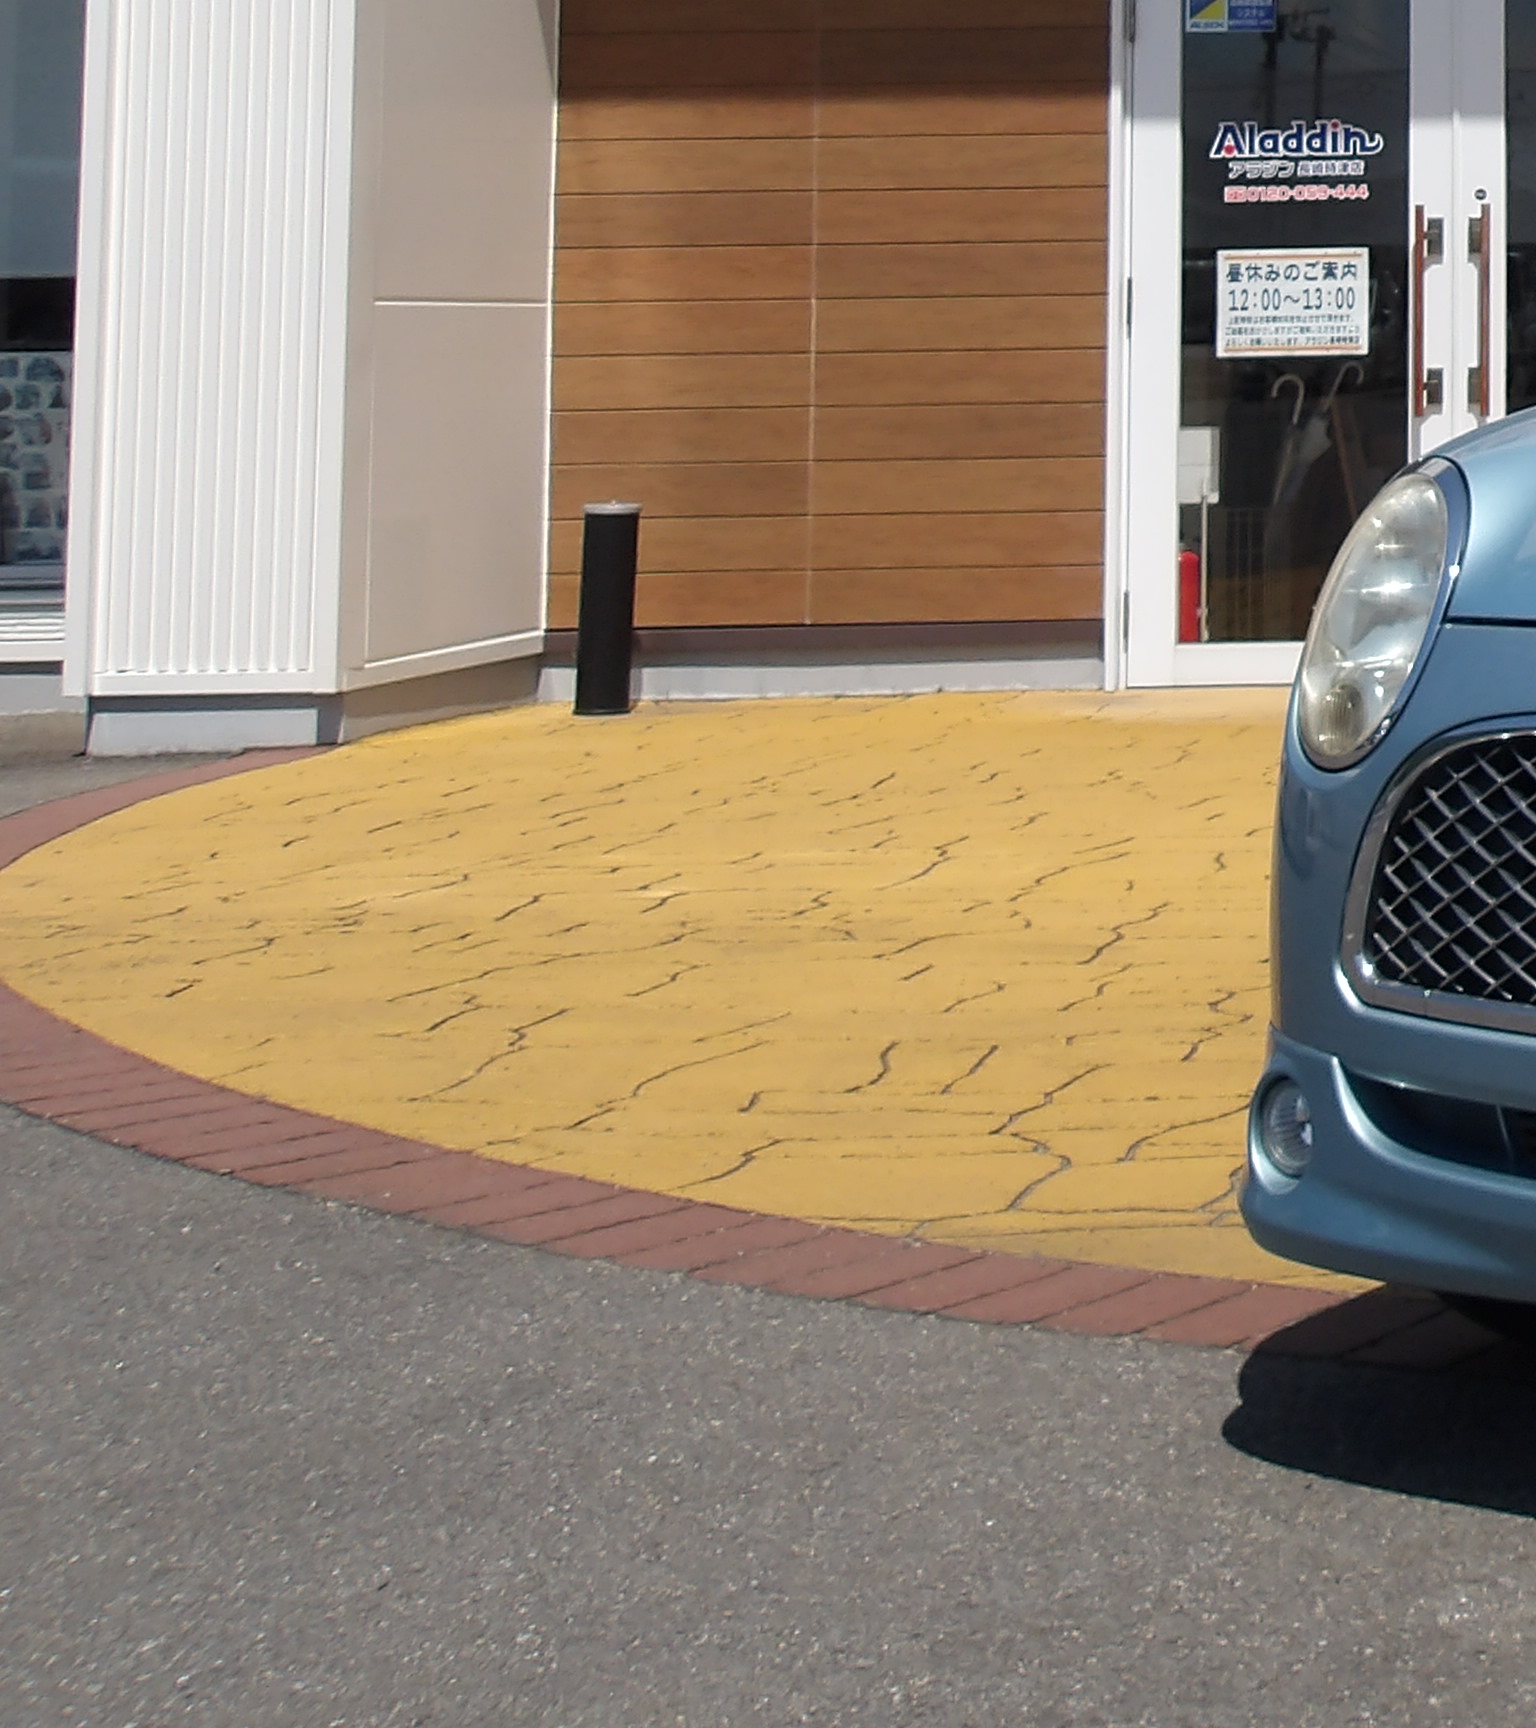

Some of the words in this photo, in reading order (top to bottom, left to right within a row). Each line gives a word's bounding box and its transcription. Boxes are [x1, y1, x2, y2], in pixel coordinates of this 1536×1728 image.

[1209, 118, 1384, 158] Aladdin
[1228, 160, 1295, 179] アラジン
[1226, 261, 1358, 283] 昼休みのご案内
